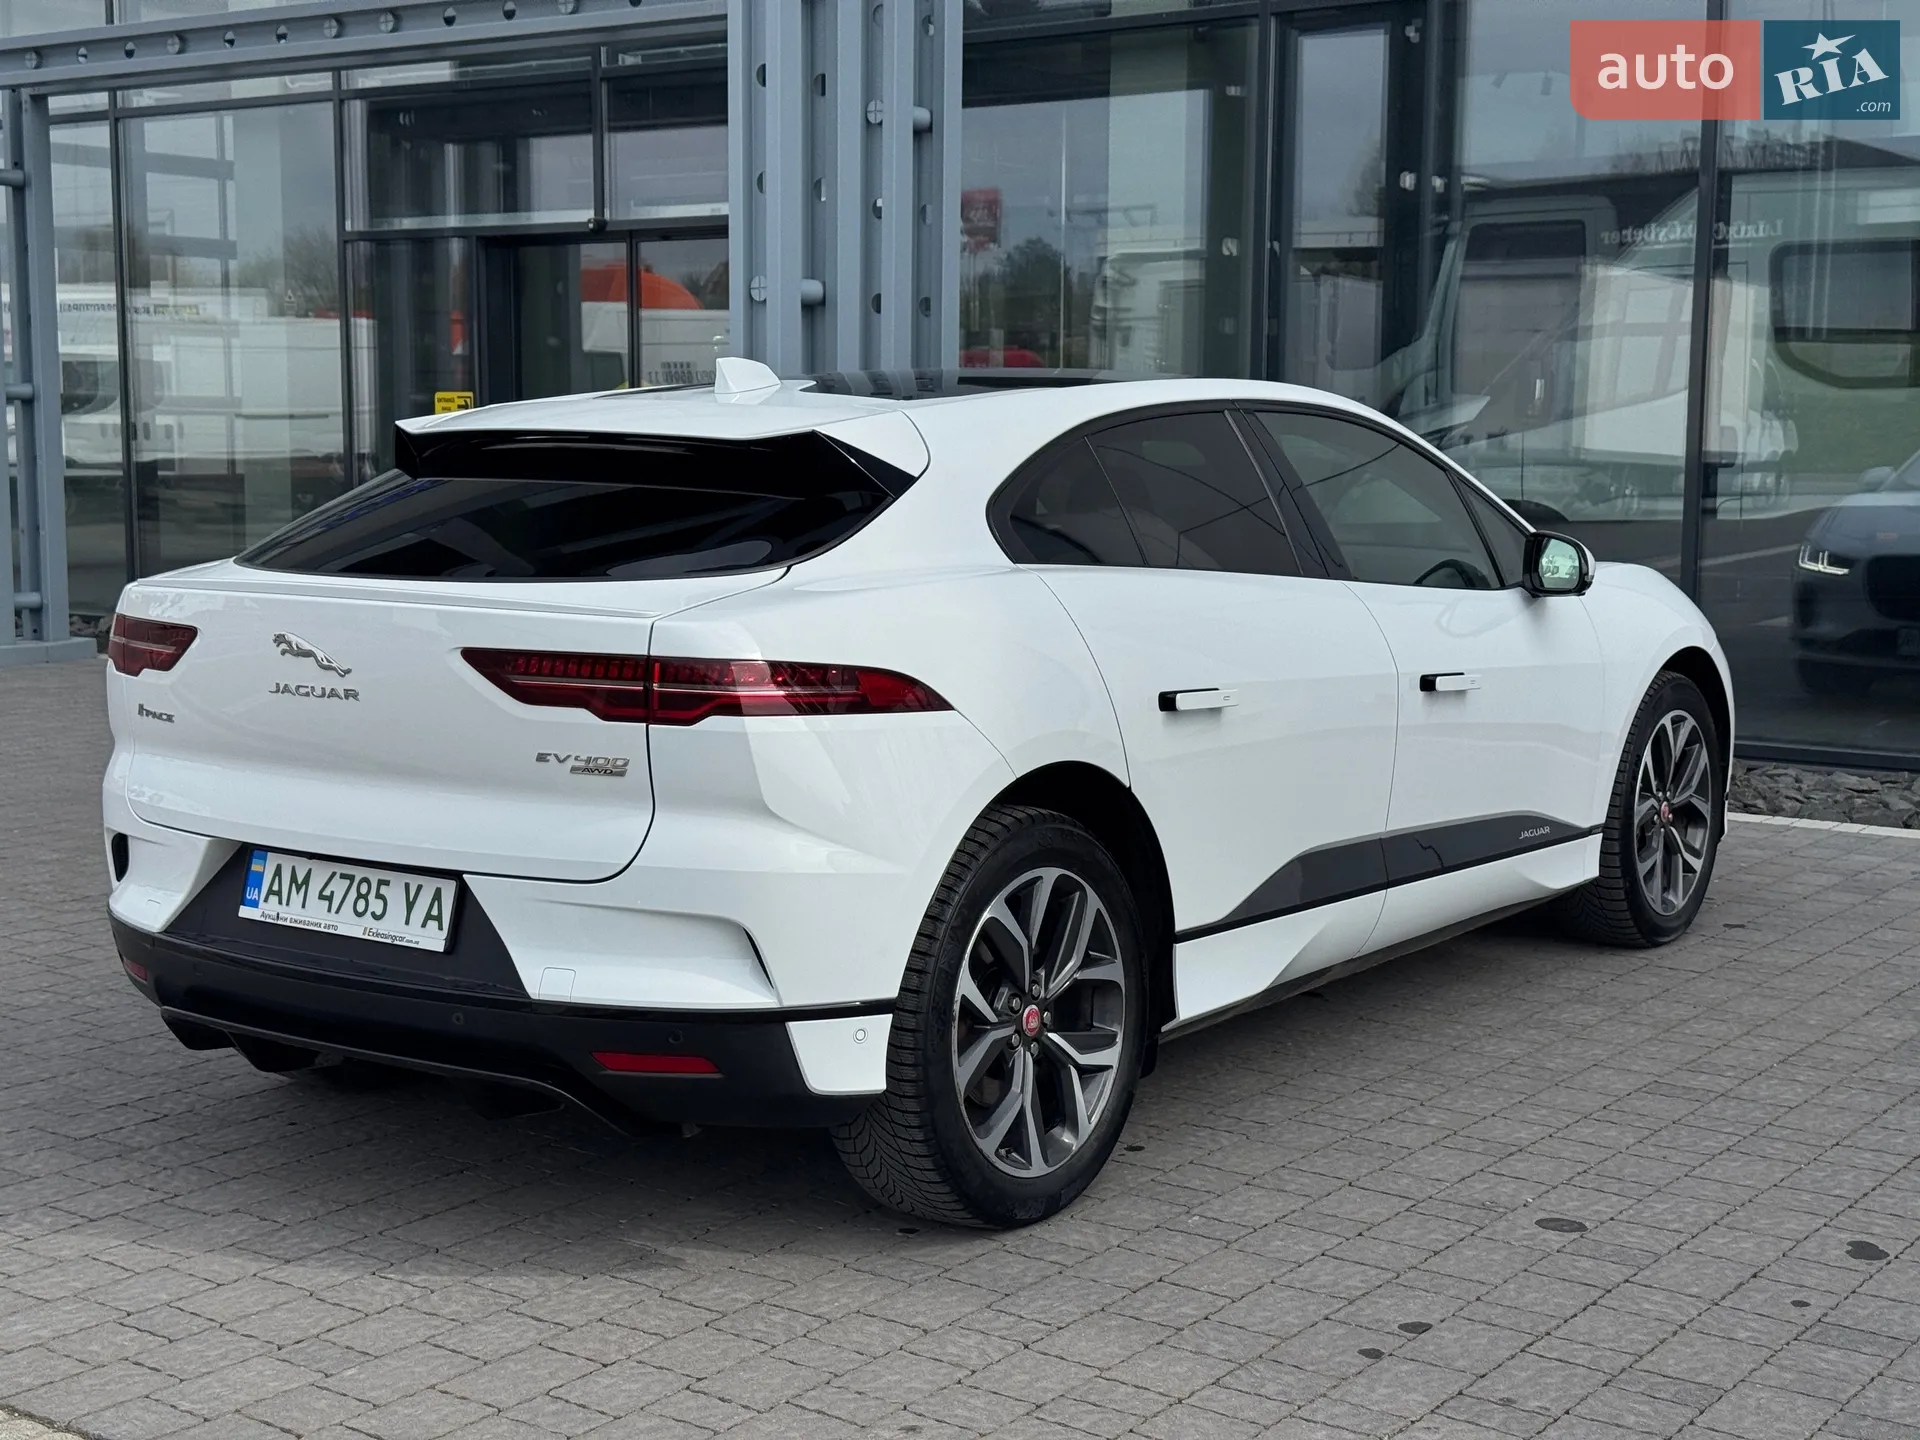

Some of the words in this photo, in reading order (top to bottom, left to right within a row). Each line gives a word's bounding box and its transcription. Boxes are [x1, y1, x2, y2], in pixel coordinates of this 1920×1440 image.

[268, 682, 360, 702] JAGUAR
[581, 767, 614, 775] AWD
[1518, 826, 1551, 840] JAGUAR
[246, 886, 259, 901] UA
[263, 863, 313, 909] AM
[317, 871, 391, 921] 4785
[404, 882, 444, 931] YA
[260, 910, 288, 922] Аукцни
[288, 917, 322, 929] вживаних
[322, 922, 339, 931] авто
